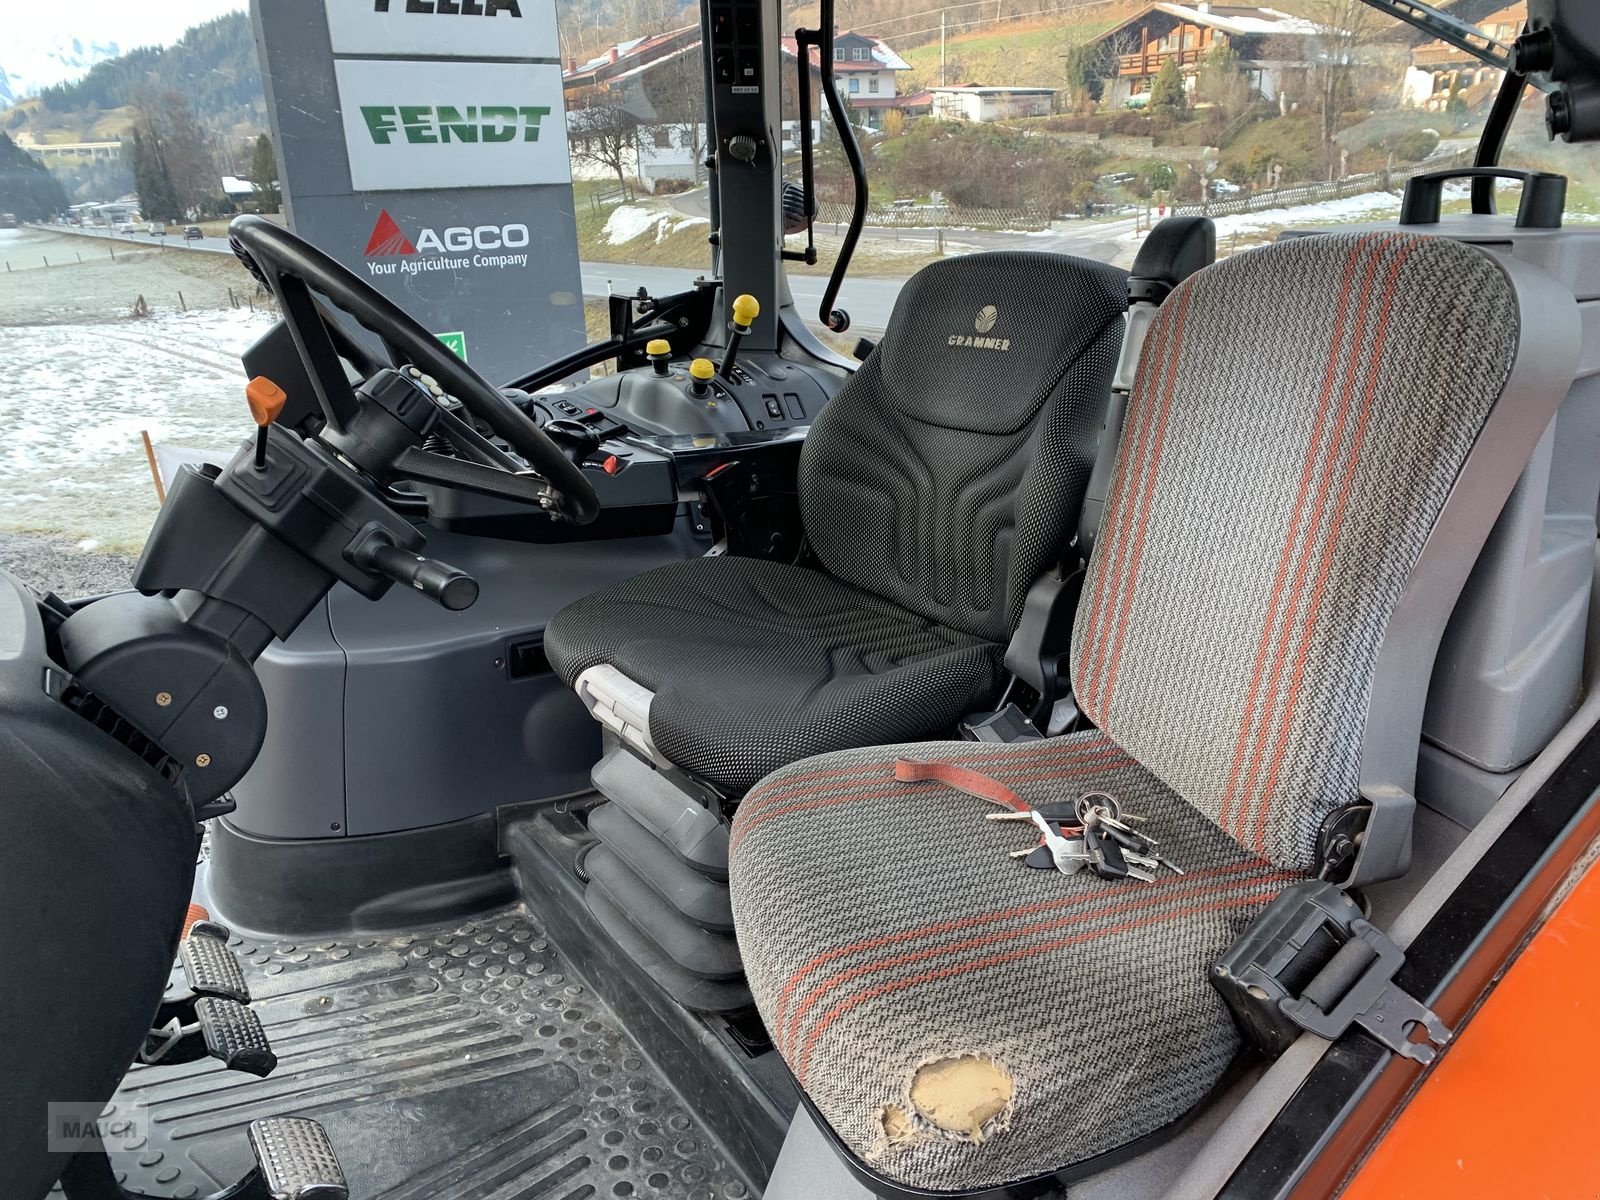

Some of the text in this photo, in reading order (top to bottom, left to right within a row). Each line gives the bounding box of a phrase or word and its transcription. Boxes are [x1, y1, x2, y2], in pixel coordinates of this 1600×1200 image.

[360, 106, 551, 144] FENDT
[416, 223, 529, 253] AGCO
[367, 254, 528, 275] Your Agriculture Company
[948, 334, 1010, 351] GRAMMER
